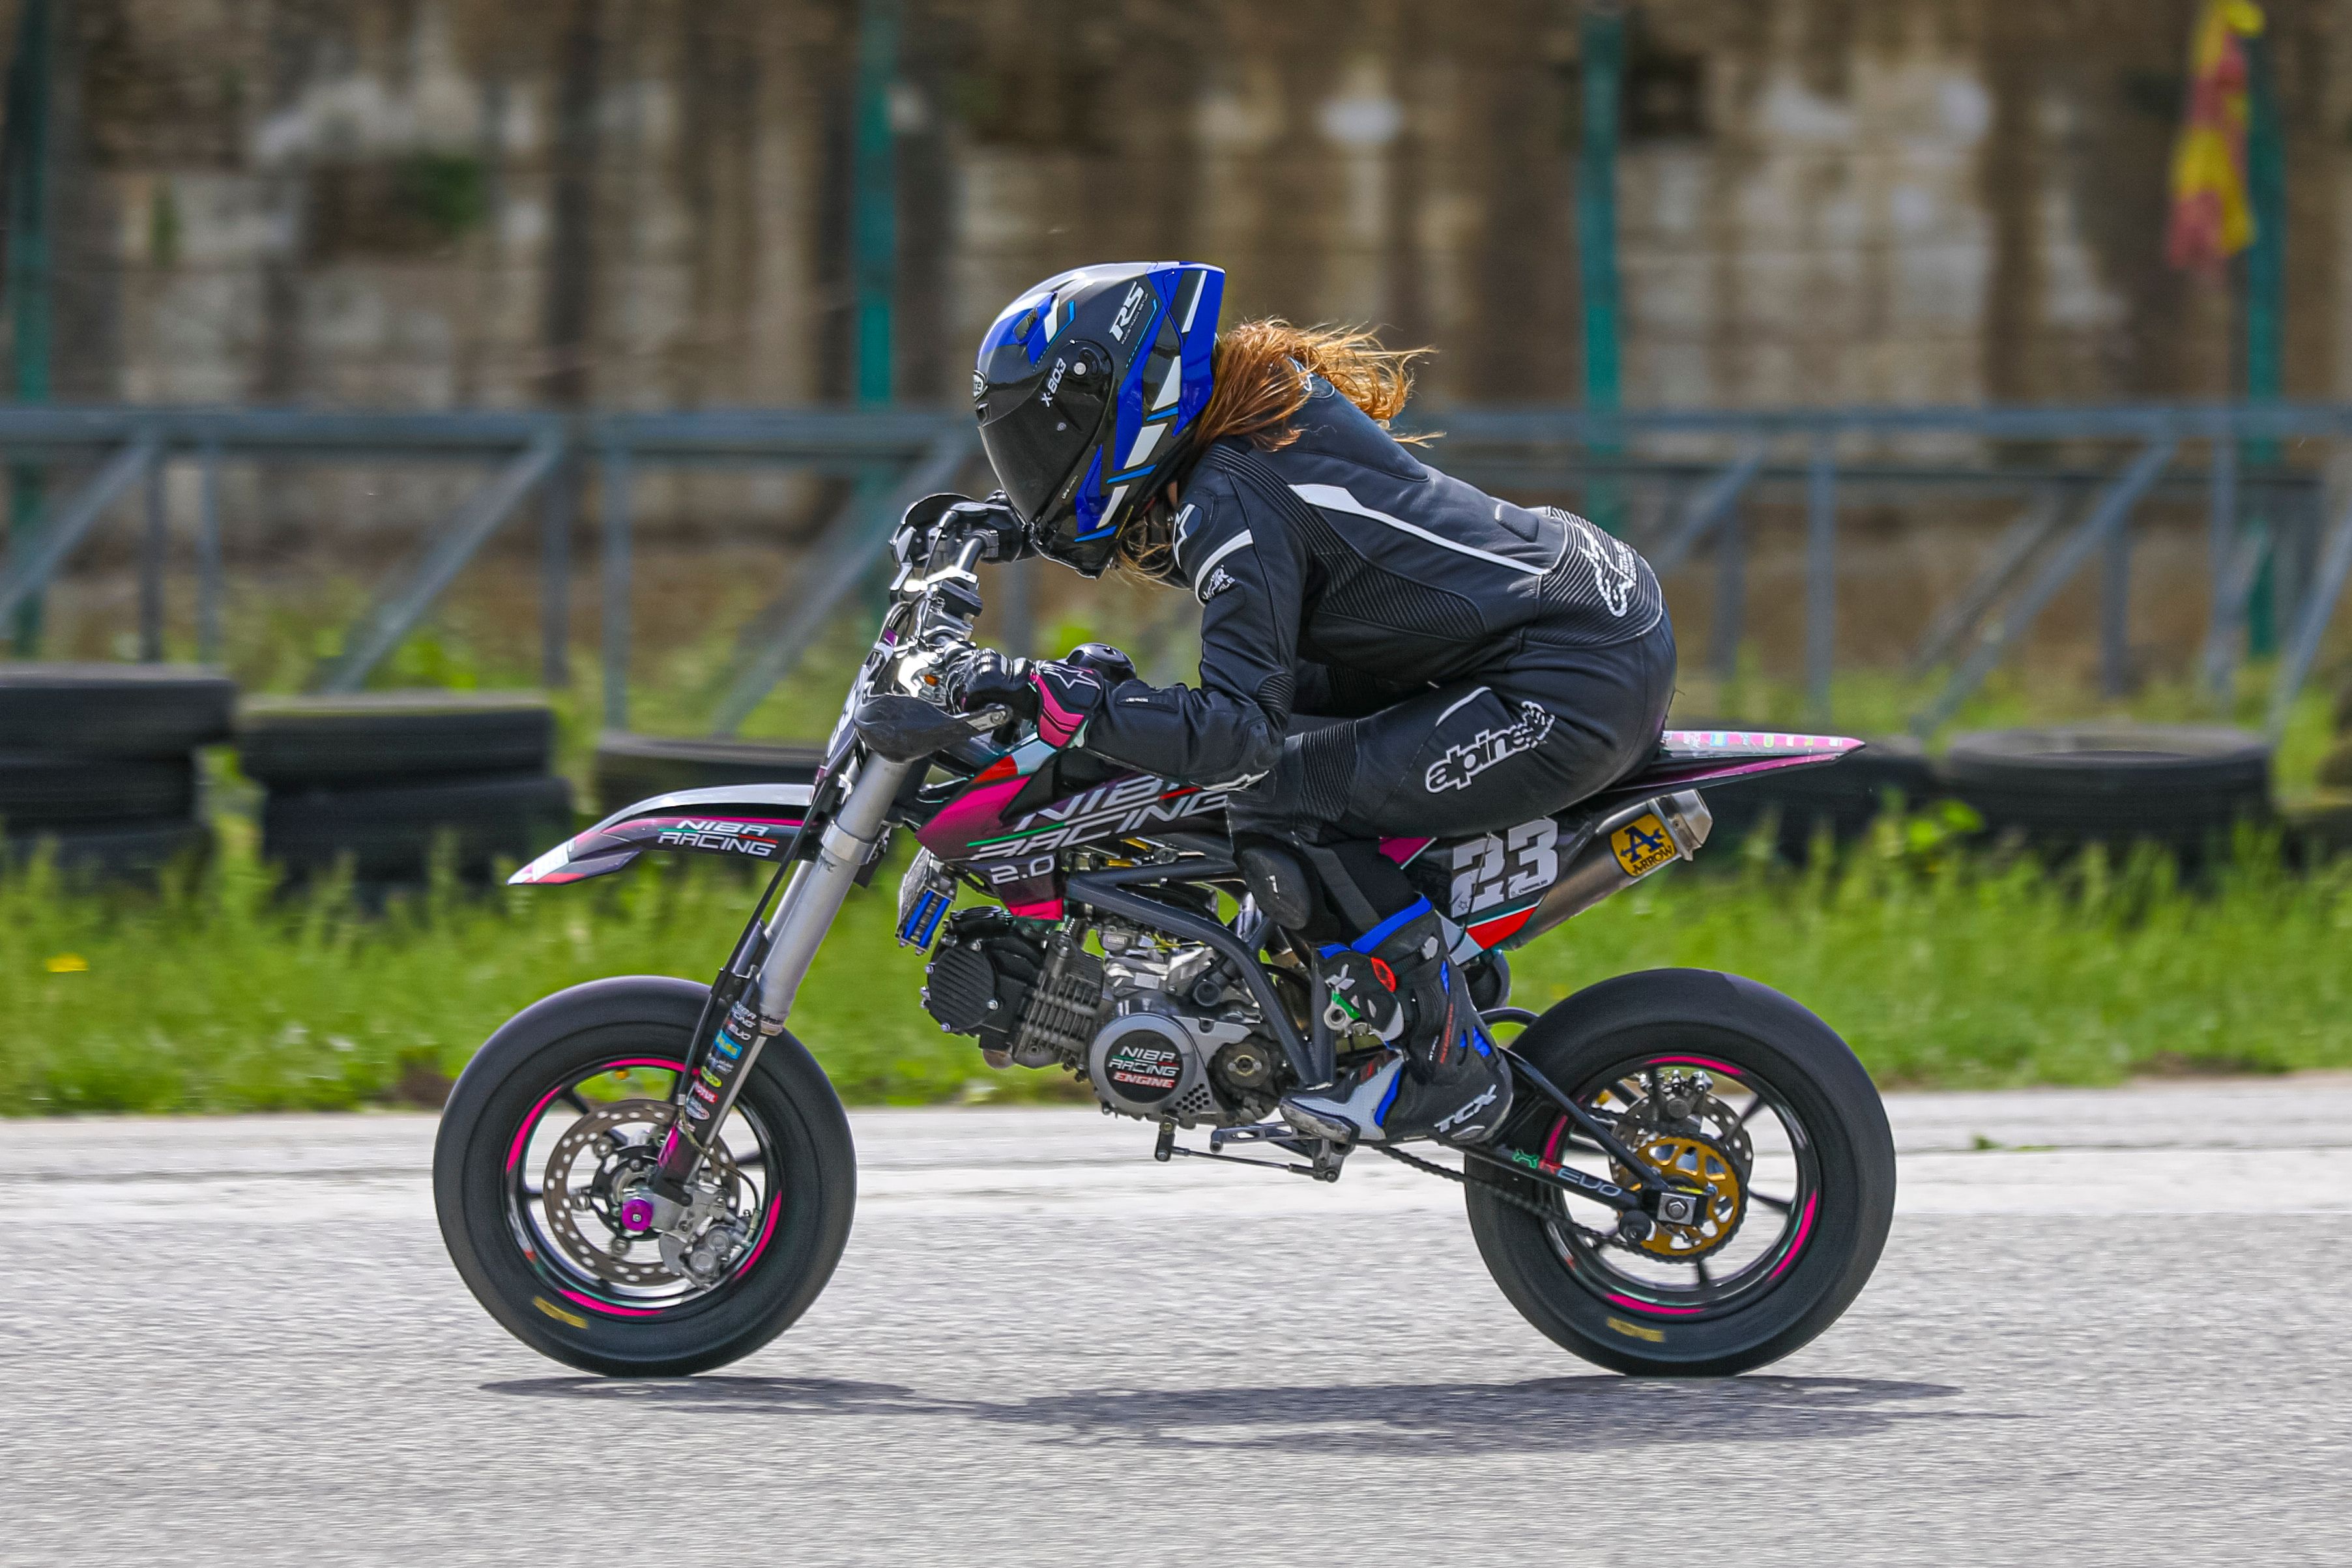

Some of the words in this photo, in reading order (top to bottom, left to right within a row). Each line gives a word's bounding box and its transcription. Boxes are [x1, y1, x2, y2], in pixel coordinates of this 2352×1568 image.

[1109, 281, 1144, 341] RS
[1013, 774, 1164, 833] NIB
[657, 832, 777, 857] RACING
[970, 793, 1229, 862] RACING
[991, 855, 1054, 885] 2.0
[1451, 816, 1558, 918] 23
[1632, 845, 1673, 874] ARROW
[1108, 1058, 1180, 1077] RACING
[1113, 1071, 1175, 1089] ENGINE
[1434, 1084, 1497, 1133] TCX
